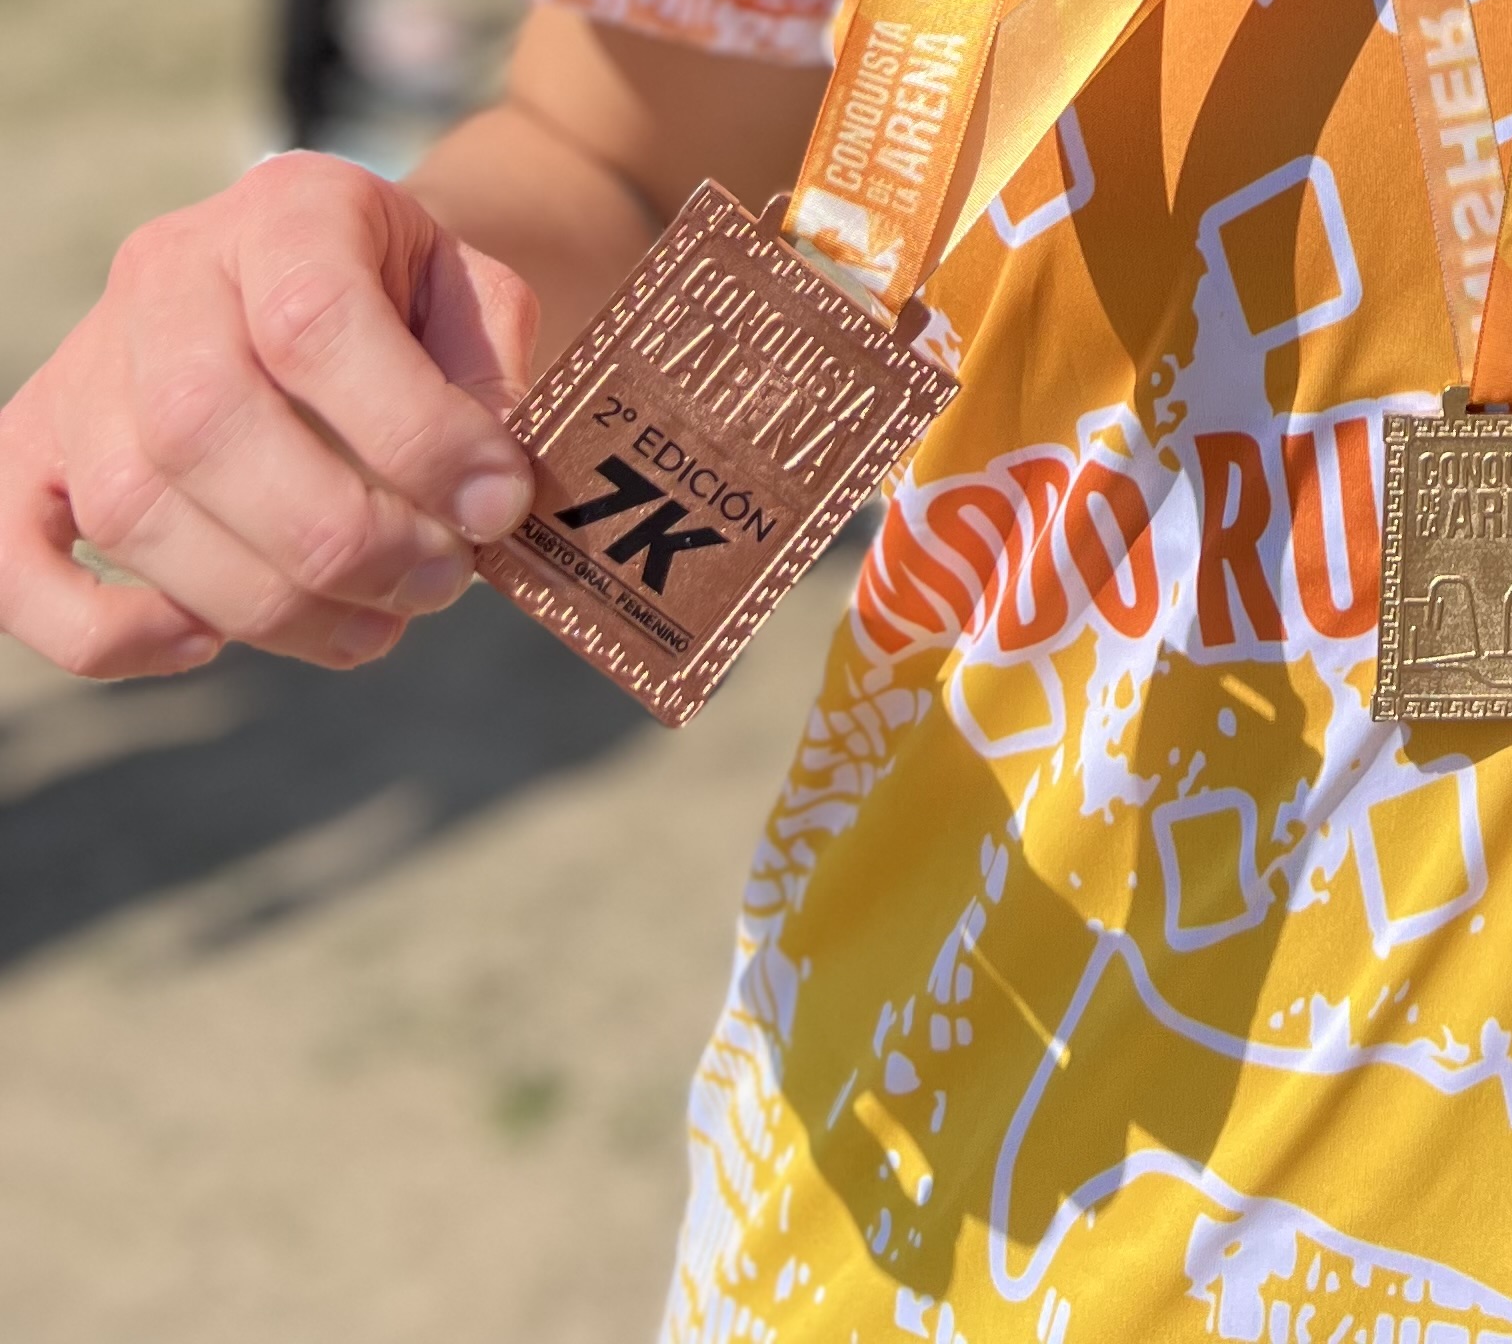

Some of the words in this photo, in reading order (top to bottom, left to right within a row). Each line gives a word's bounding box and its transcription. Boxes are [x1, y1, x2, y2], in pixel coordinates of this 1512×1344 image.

[825, 20, 912, 193] CONQUISTA
[875, 33, 968, 185] ARENA
[660, 324, 847, 489] ARENA
[681, 257, 877, 432] CONQUISTA
[553, 453, 730, 596] 7K
[632, 425, 778, 543] EDICIÓN
[615, 592, 692, 654] FEMENINO
